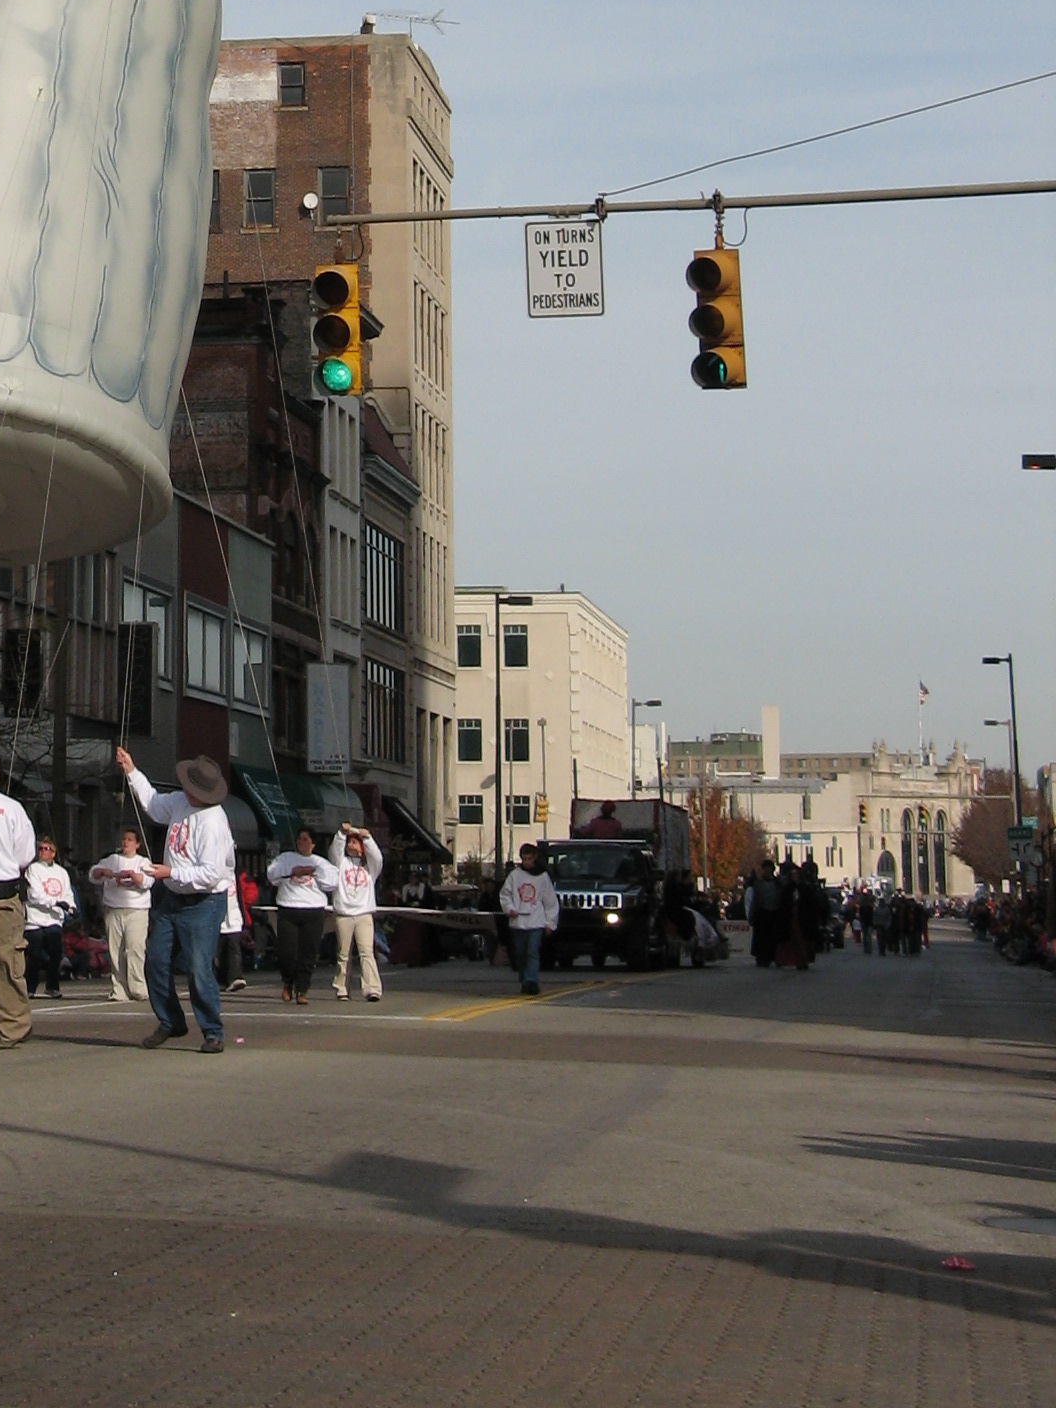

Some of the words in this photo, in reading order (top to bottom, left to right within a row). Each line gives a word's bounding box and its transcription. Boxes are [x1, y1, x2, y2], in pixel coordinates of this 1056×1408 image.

[534, 229, 550, 245] ON
[555, 228, 595, 244] TURNS
[539, 249, 589, 268] YIELD
[554, 273, 576, 288] TO
[532, 292, 599, 309] PEDESTRIANS
